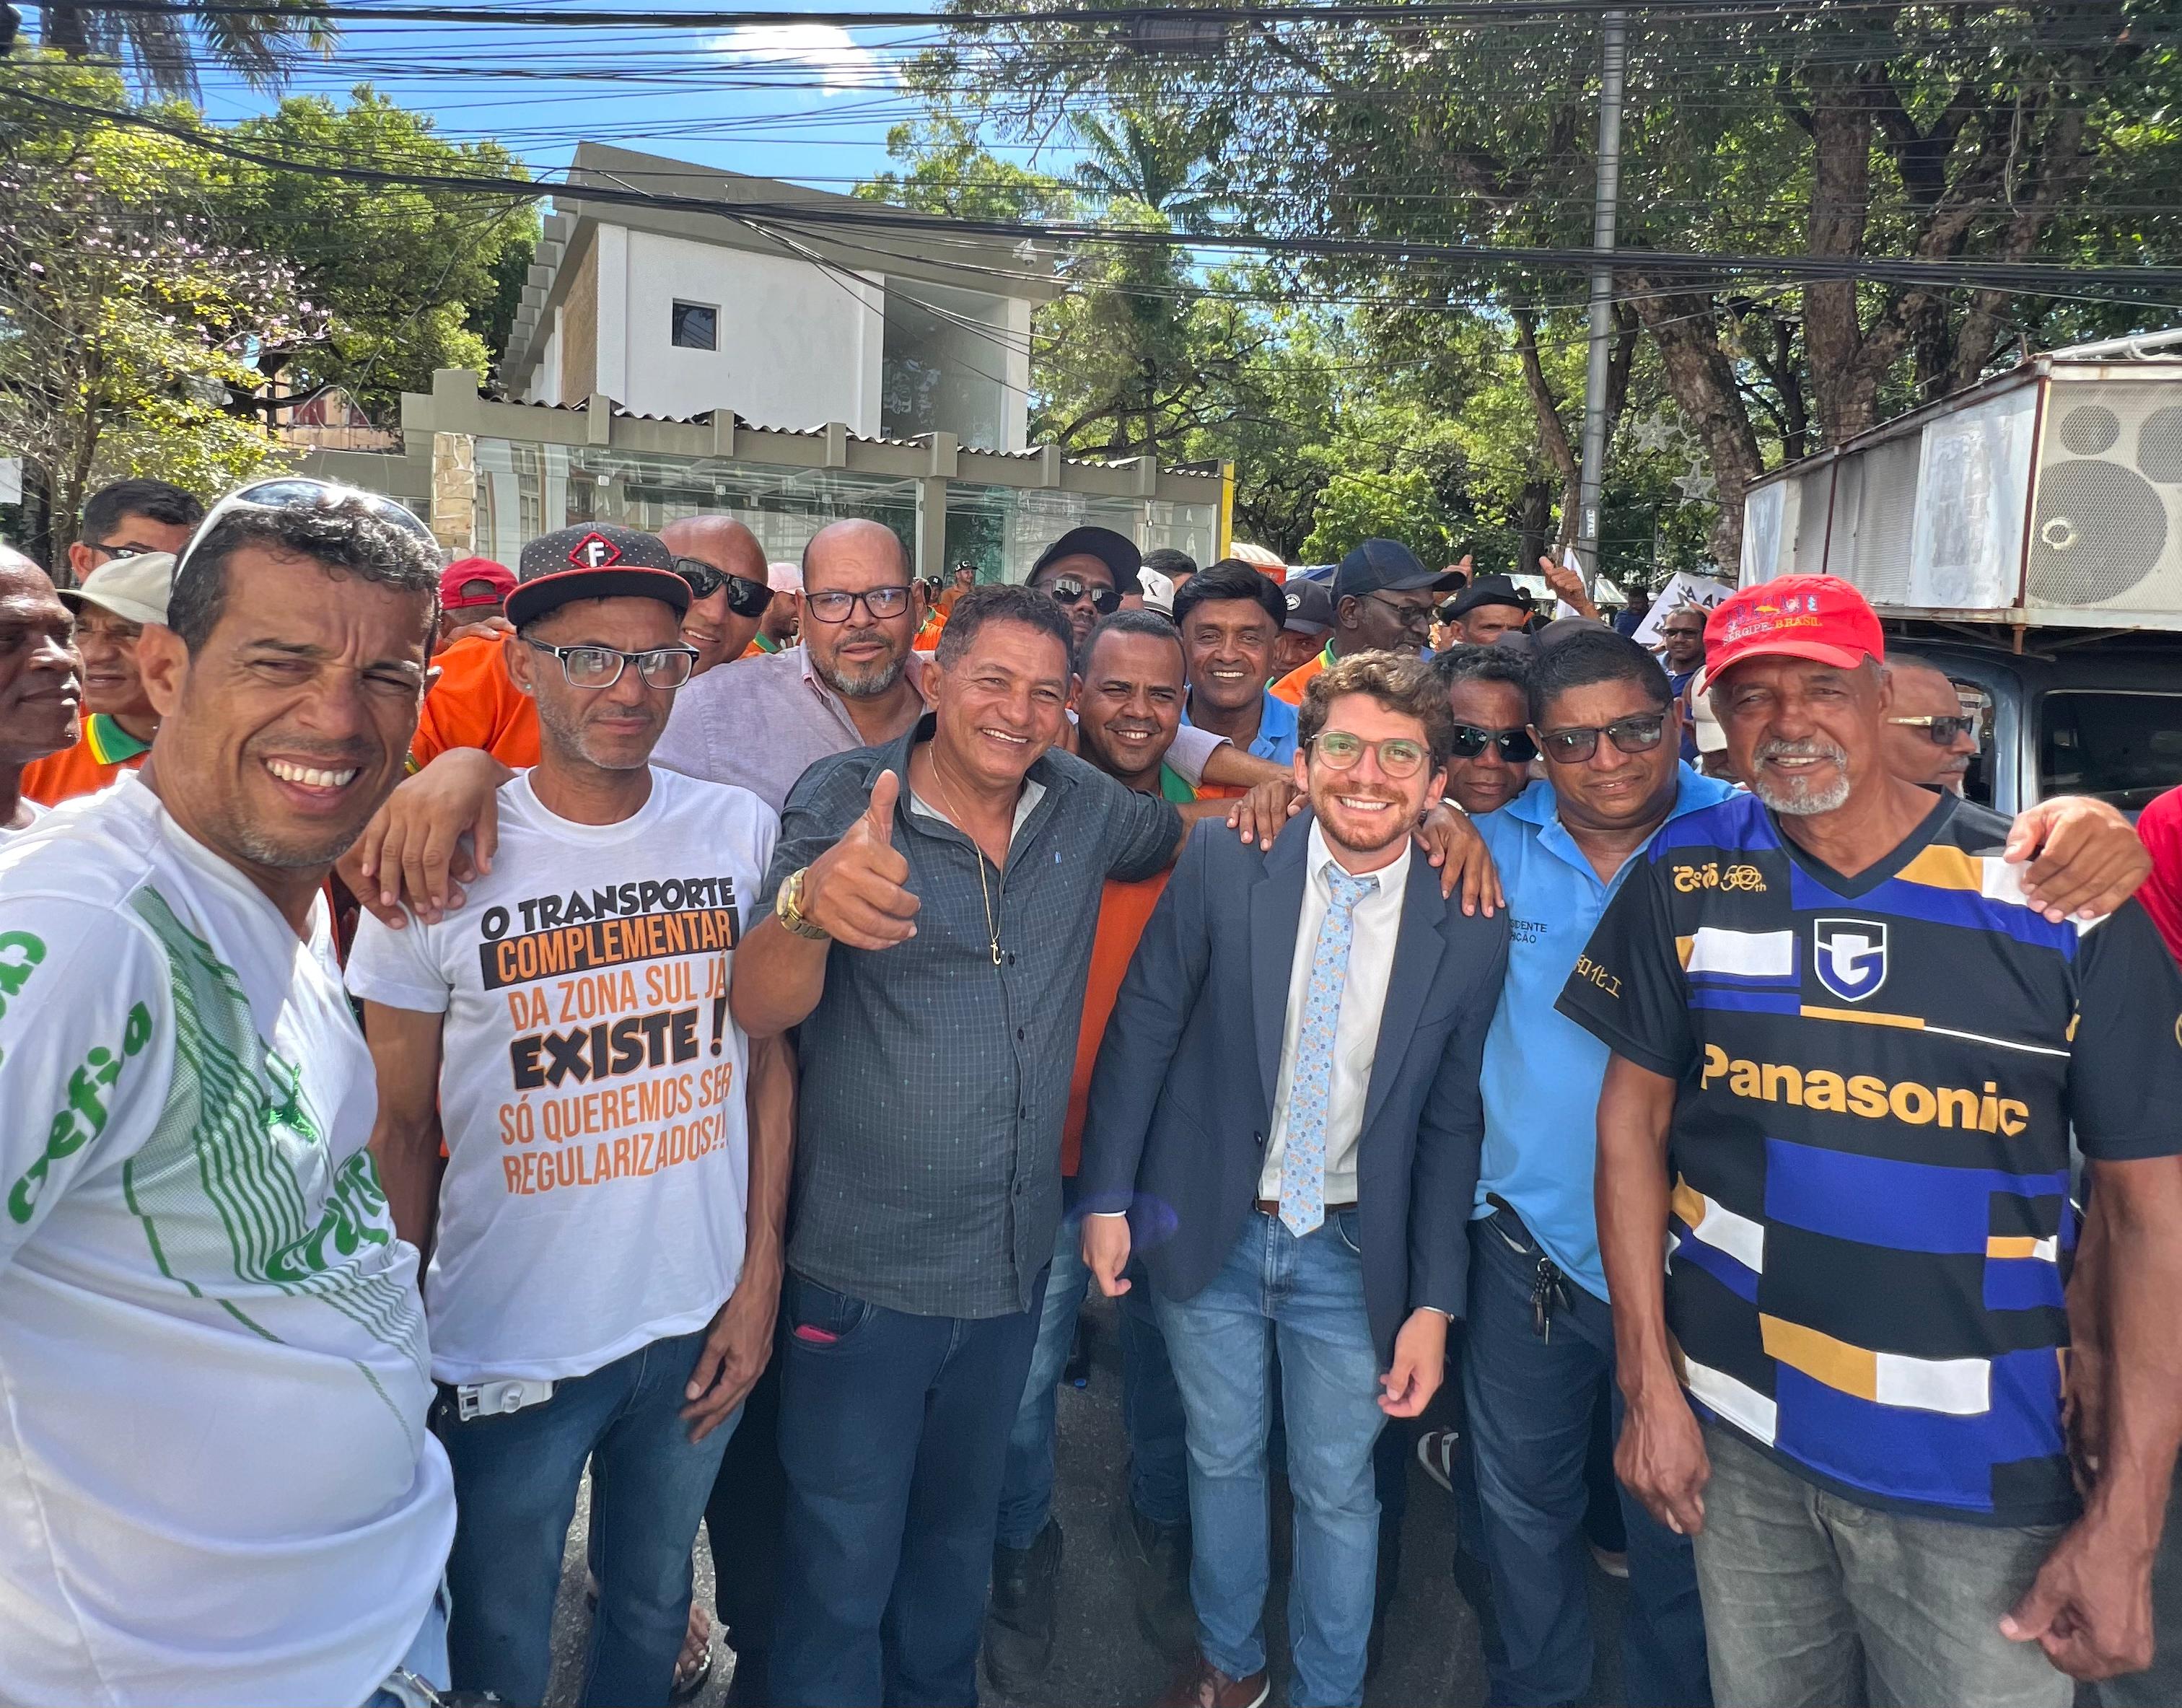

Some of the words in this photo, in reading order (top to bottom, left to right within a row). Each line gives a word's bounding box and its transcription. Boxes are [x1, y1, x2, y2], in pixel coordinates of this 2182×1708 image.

[588, 542, 605, 567] F
[481, 906, 511, 941] O
[517, 876, 736, 933] TRANSPORTE
[496, 910, 732, 983] COMPLEMENTAR
[508, 986, 551, 1031] DA
[557, 970, 639, 1024] ZONA
[645, 961, 698, 1007] SUL
[704, 949, 727, 999] JÁ
[509, 1005, 700, 1092] EXISTE
[499, 1094, 535, 1146] SÓ
[542, 1073, 693, 1144] QUEREMOS
[698, 1061, 733, 1108] SER
[1700, 1043, 2029, 1137] Panasonic
